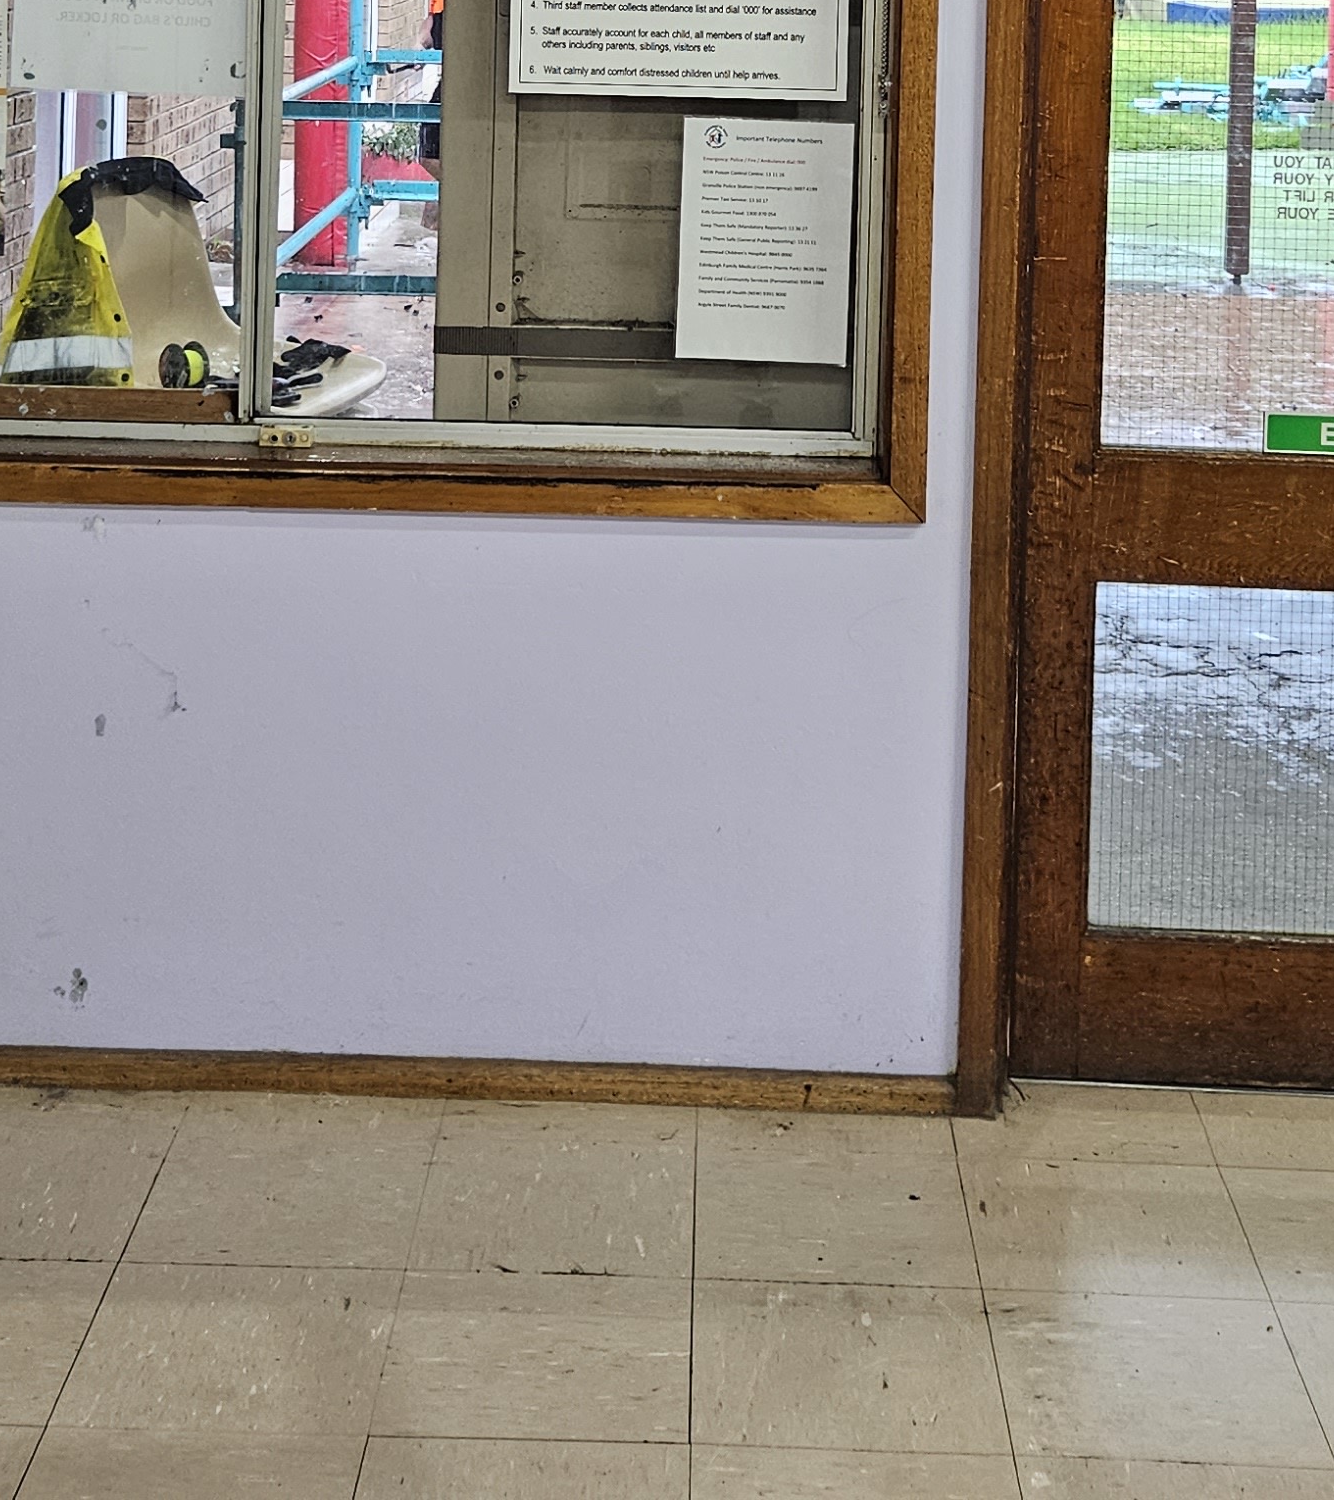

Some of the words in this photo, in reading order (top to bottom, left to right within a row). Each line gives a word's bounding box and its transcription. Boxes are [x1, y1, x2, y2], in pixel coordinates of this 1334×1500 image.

[543, 0, 563, 9] Third
[565, 1, 582, 10] staff
[584, 2, 616, 11] member
[709, 4, 723, 13] and
[762, 5, 773, 15] for
[775, 6, 816, 16] assistance
[542, 26, 560, 35] Staff
[638, 28, 648, 38] for
[650, 29, 669, 38] each
[706, 31, 742, 40] members
[744, 31, 752, 40] of
[754, 31, 771, 41] staff
[773, 32, 788, 41] and
[790, 34, 805, 43] any
[541, 40, 566, 48] others
[568, 40, 603, 51] including
[673, 43, 700, 52] visitors
[703, 44, 715, 52] etc
[590, 67, 605, 75] and
[607, 66, 637, 76] comfort
[639, 68, 679, 77] distressed
[681, 69, 712, 78] children
[732, 70, 749, 81] help
